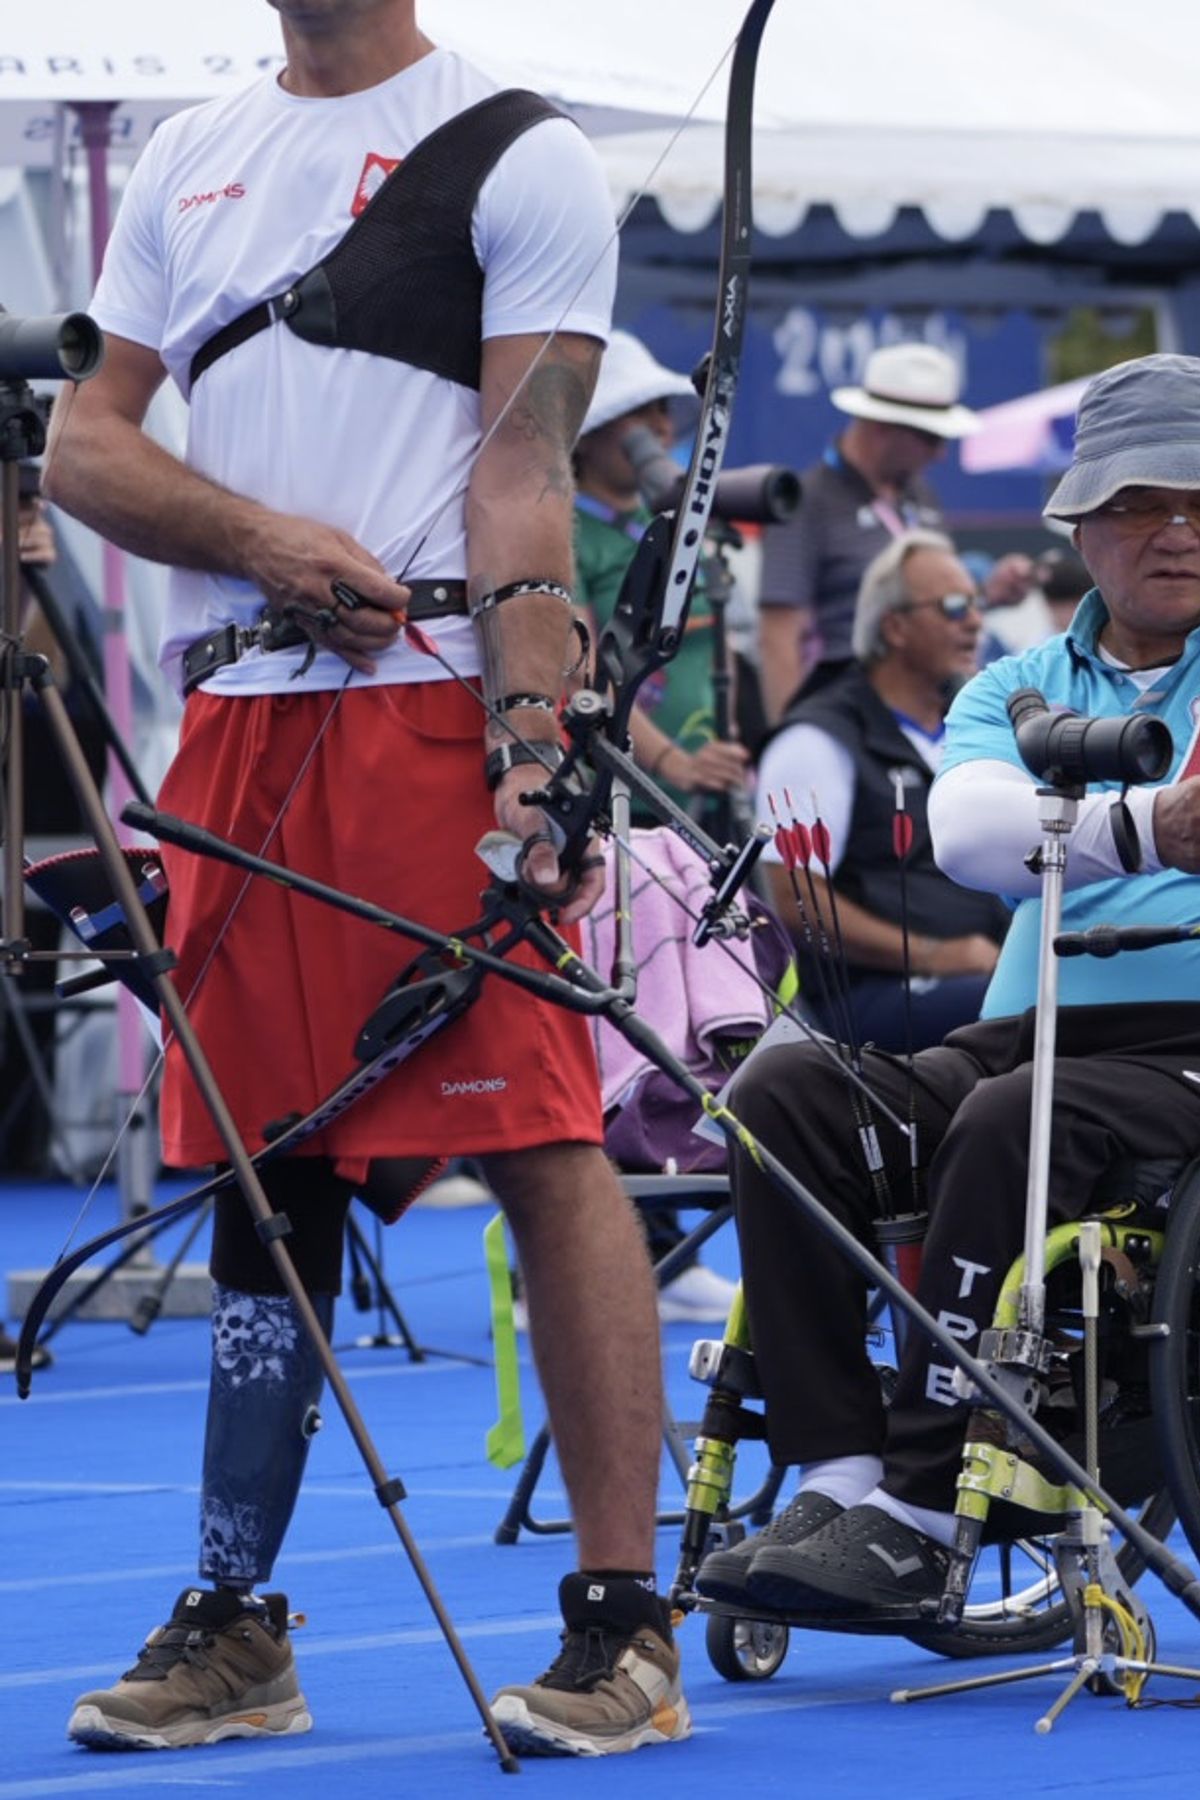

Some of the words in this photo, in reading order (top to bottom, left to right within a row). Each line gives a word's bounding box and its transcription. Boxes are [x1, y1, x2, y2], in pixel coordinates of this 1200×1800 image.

[690, 388, 728, 515] HOYT
[441, 1077, 506, 1096] DAMONS
[925, 1254, 992, 1407] TPE
